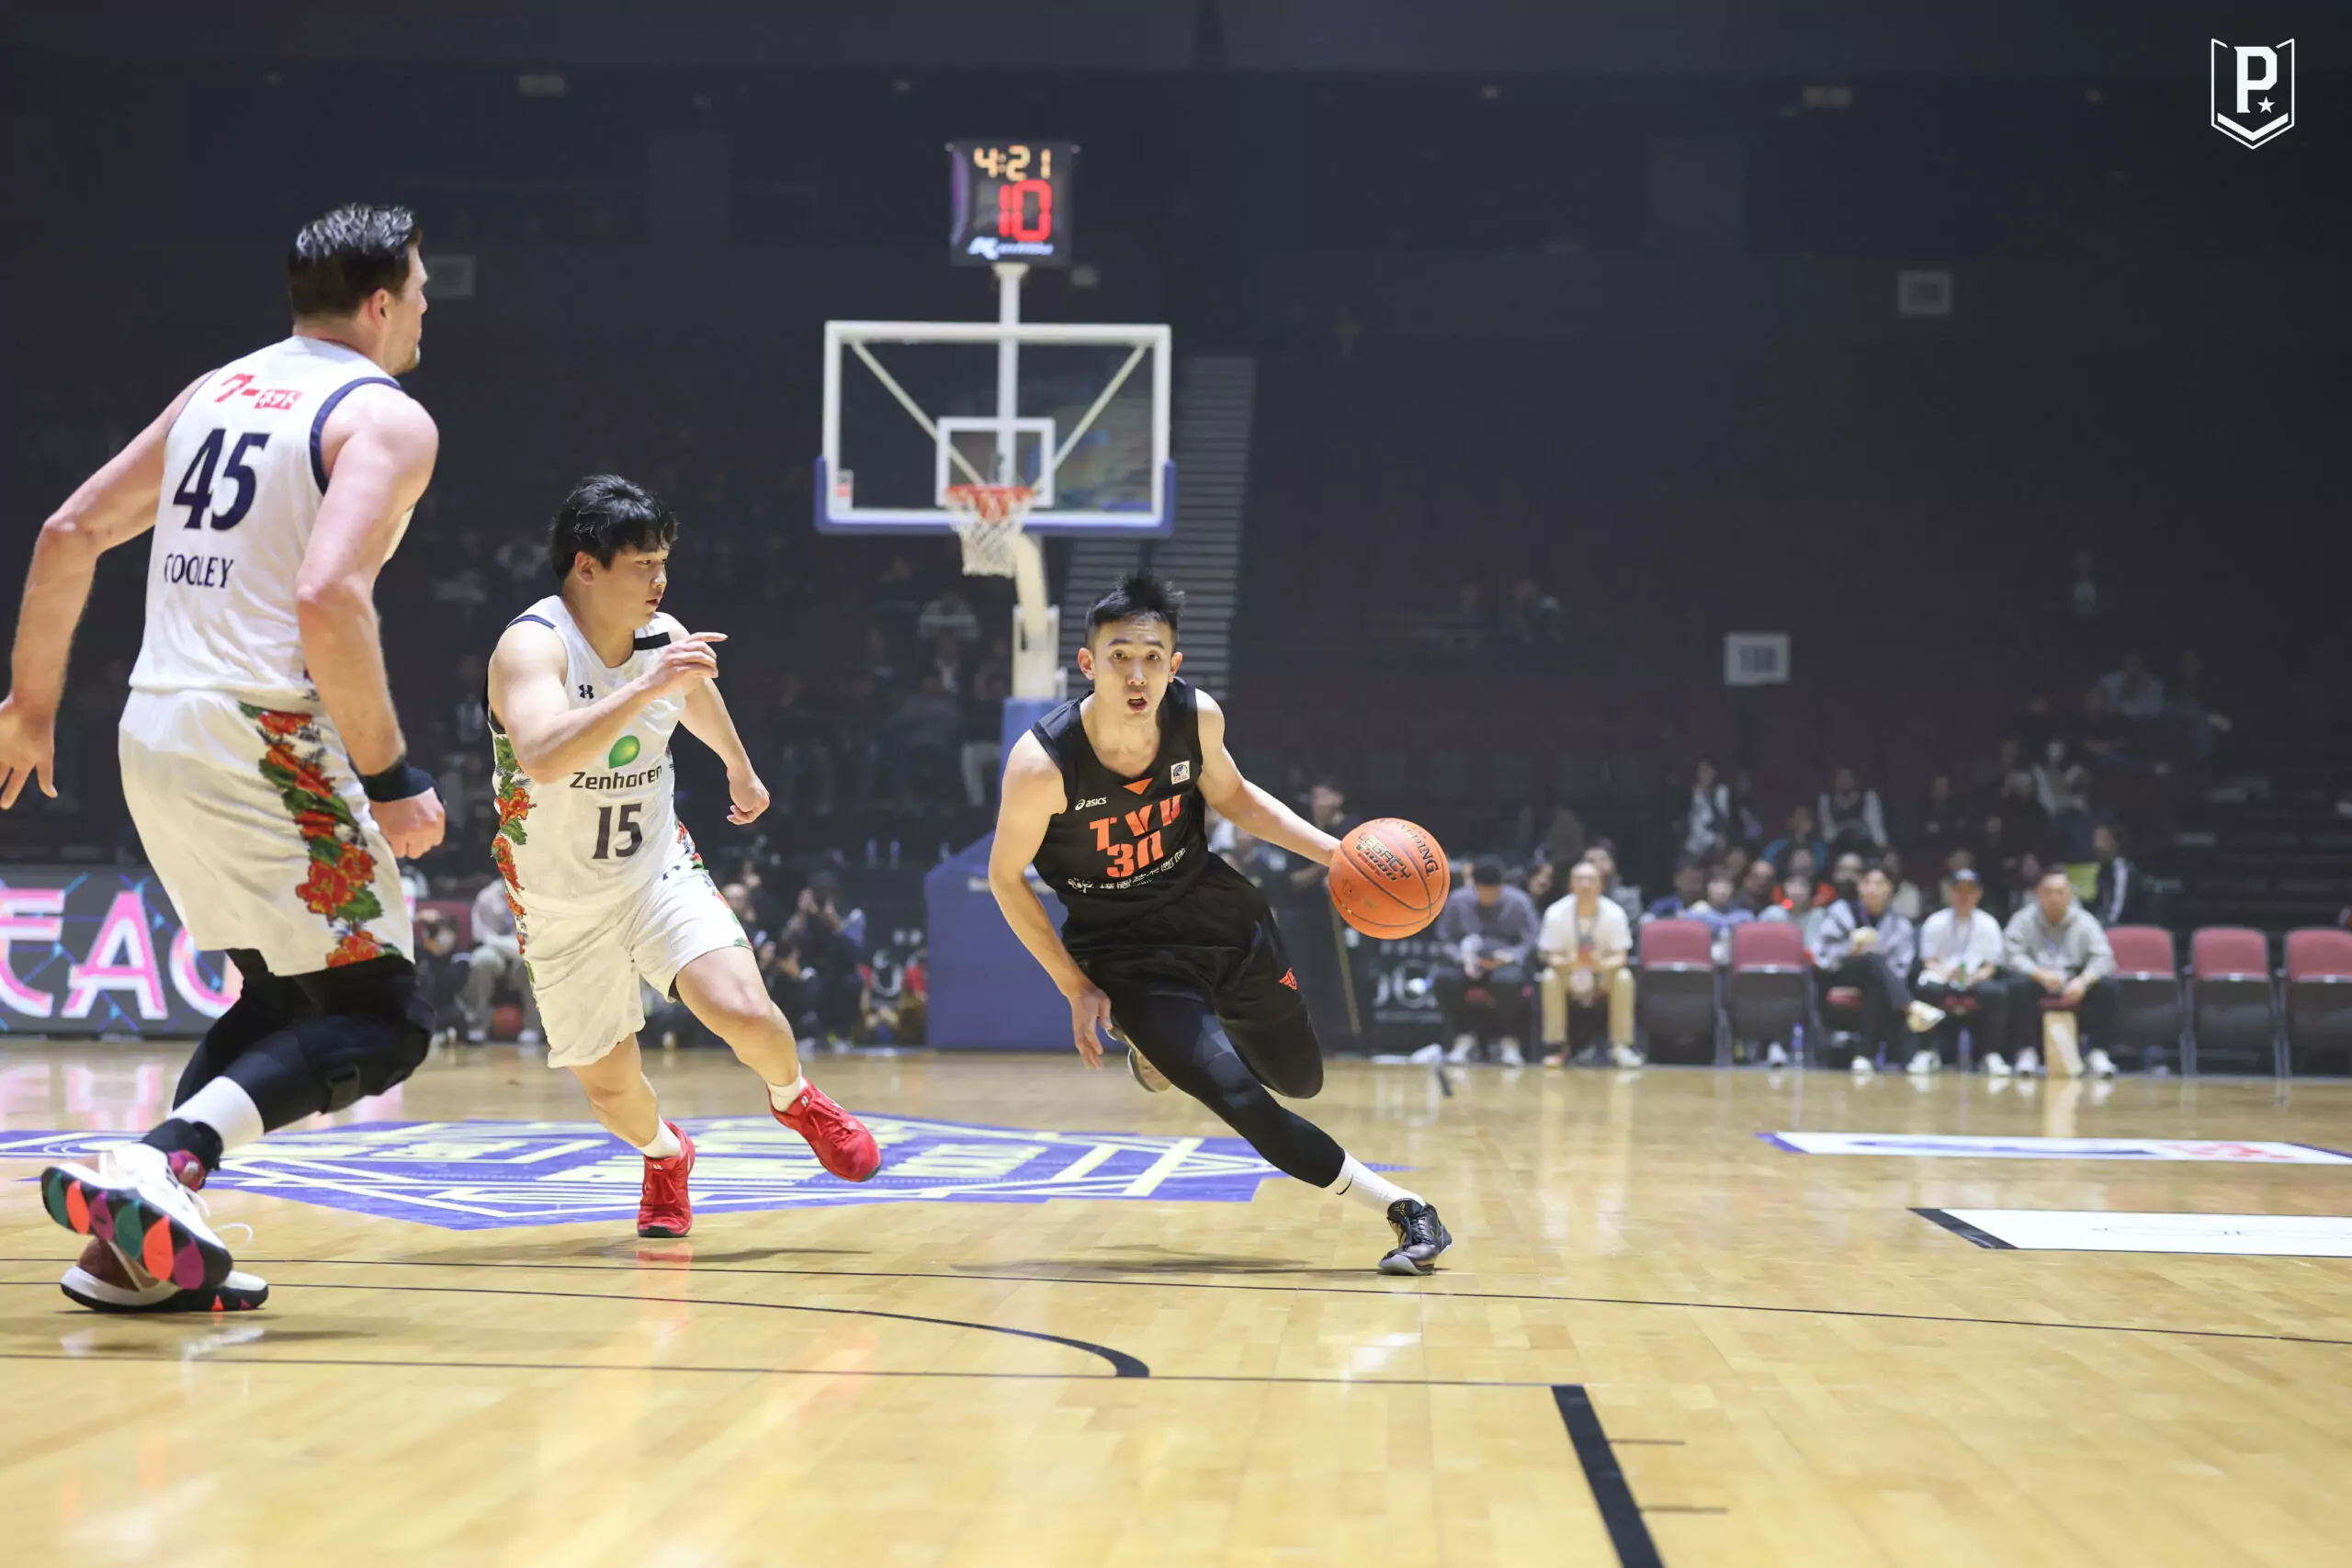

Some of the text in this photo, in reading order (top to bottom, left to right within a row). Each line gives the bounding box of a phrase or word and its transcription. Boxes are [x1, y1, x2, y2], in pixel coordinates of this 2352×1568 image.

[973, 145, 1052, 182] 4:21
[998, 179, 1053, 243] 10
[173, 427, 273, 532] 45
[164, 553, 234, 589] COOLEY
[569, 764, 662, 790] Zenhoren
[1085, 796, 1107, 808] asics
[591, 802, 643, 860] 15
[1106, 829, 1165, 878] 30
[1357, 831, 1412, 880] LEGACY
